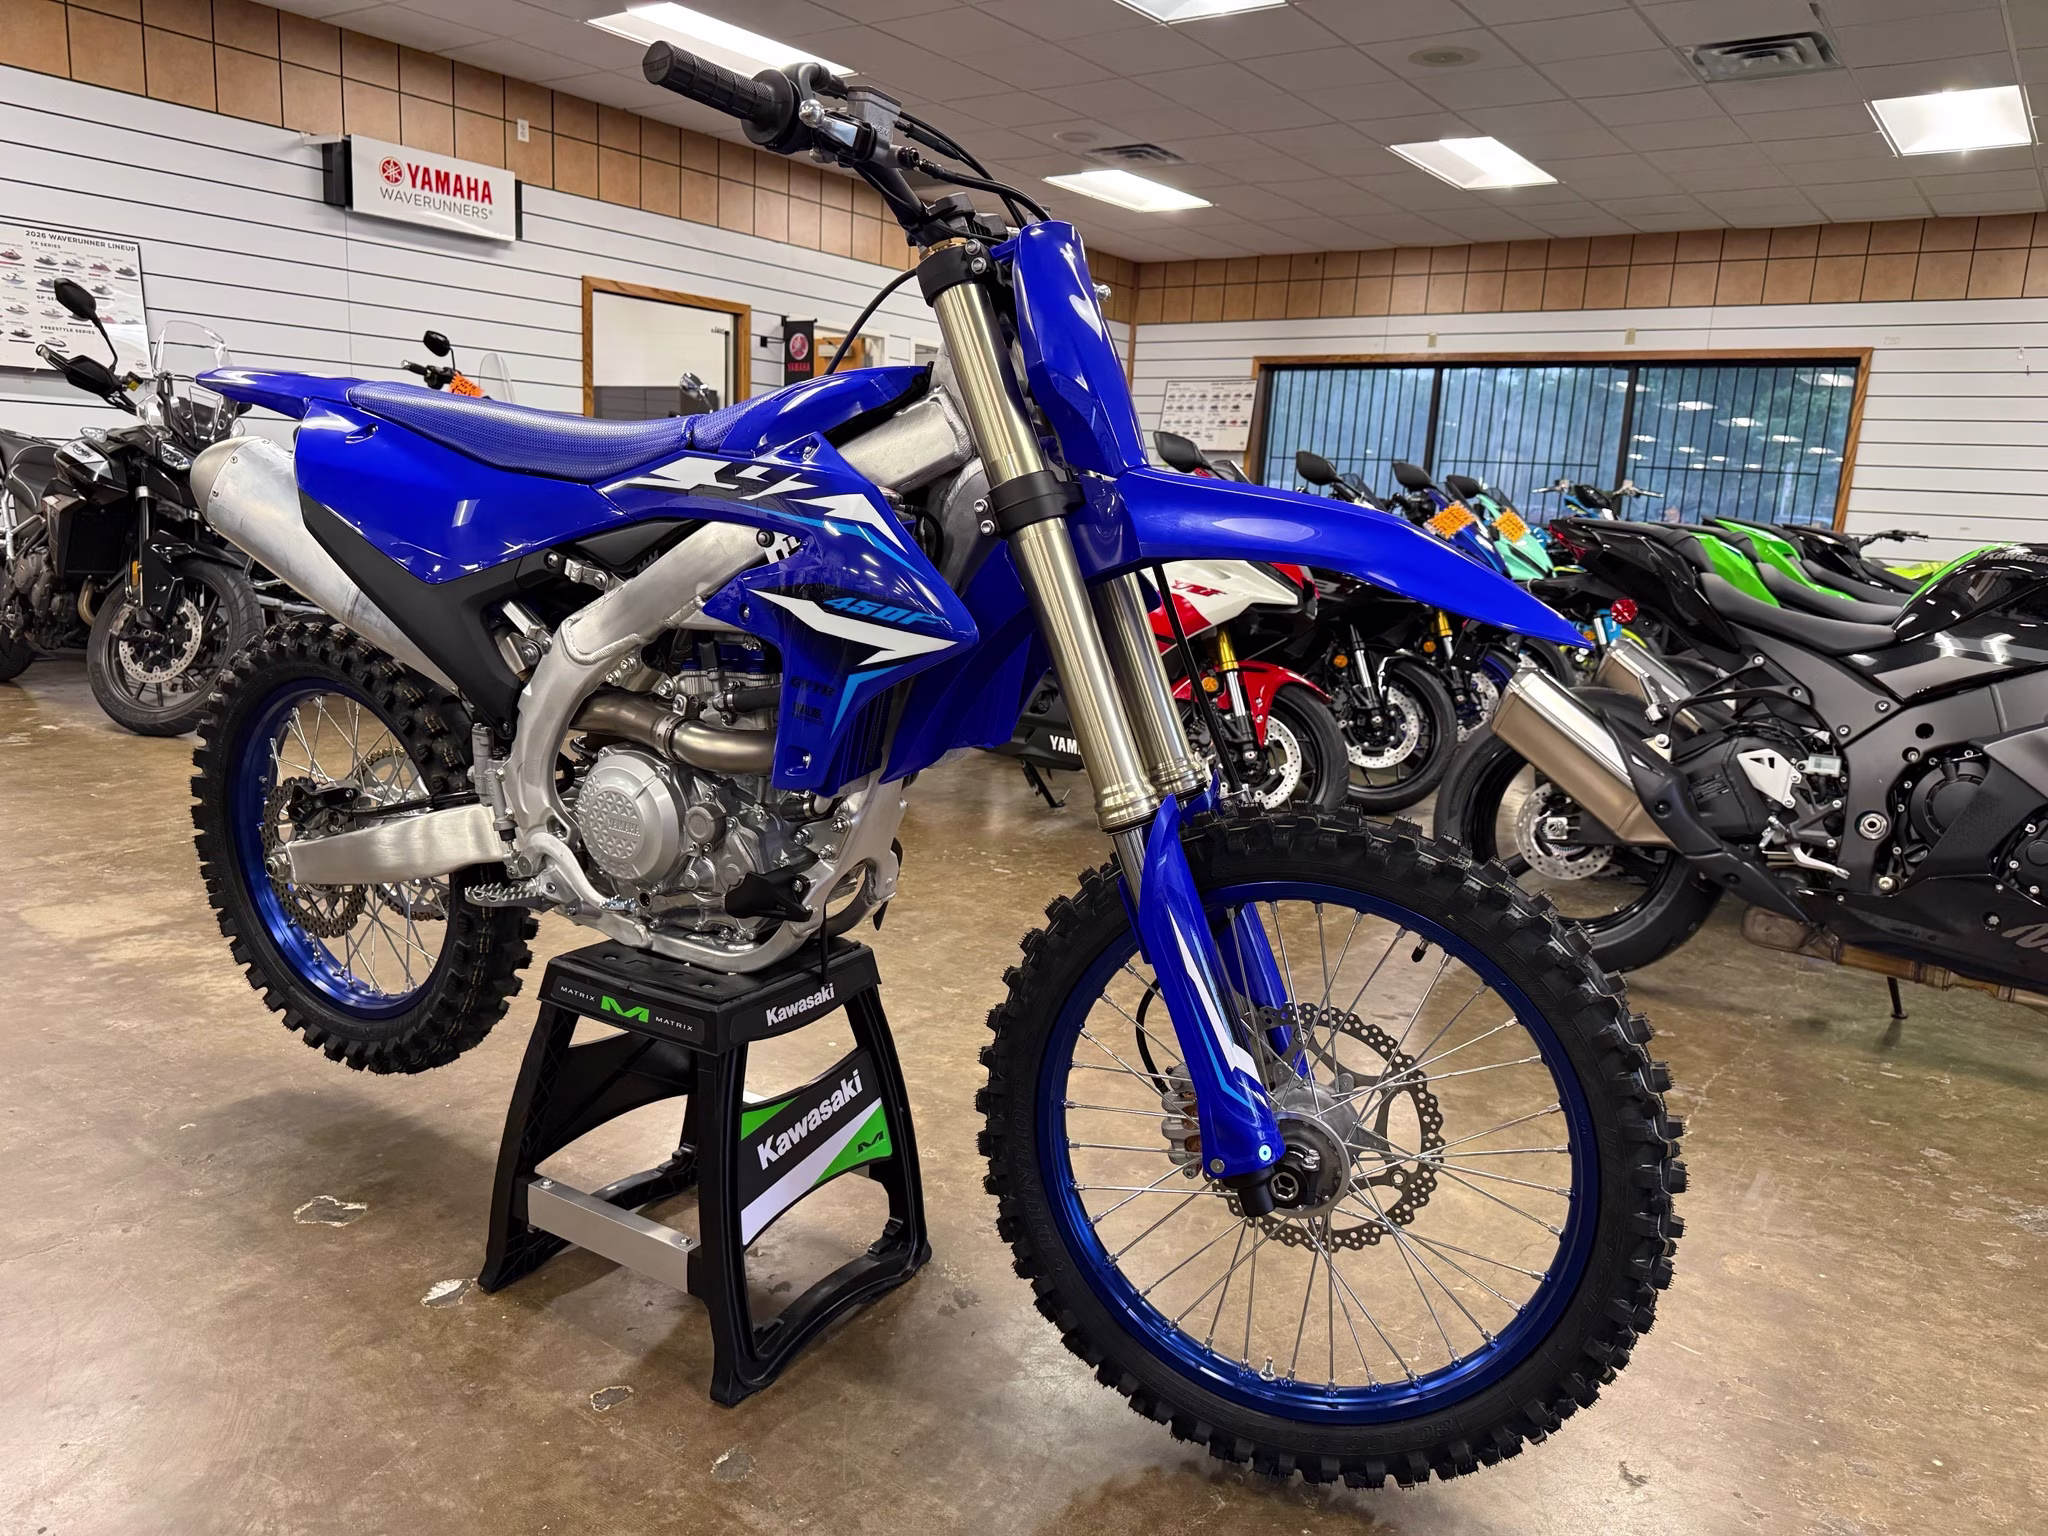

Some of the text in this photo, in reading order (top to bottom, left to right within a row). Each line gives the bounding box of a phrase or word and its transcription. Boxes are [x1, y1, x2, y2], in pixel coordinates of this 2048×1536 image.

[406, 162, 493, 205] YAMAHA
[25, 230, 136, 252] 2026 WAVERUNNER LINEUP
[40, 325, 73, 333] FREESTYLE
[787, 362, 811, 372] YAMAHA
[1982, 550, 2048, 565] Kawasa
[823, 597, 947, 625] 450F
[608, 818, 641, 837] YAMAHA
[560, 986, 595, 1002] MATRIX
[655, 1016, 693, 1031] MATRIX
[766, 983, 835, 1026] Kawasaki
[756, 1068, 863, 1171] Kawasaki
